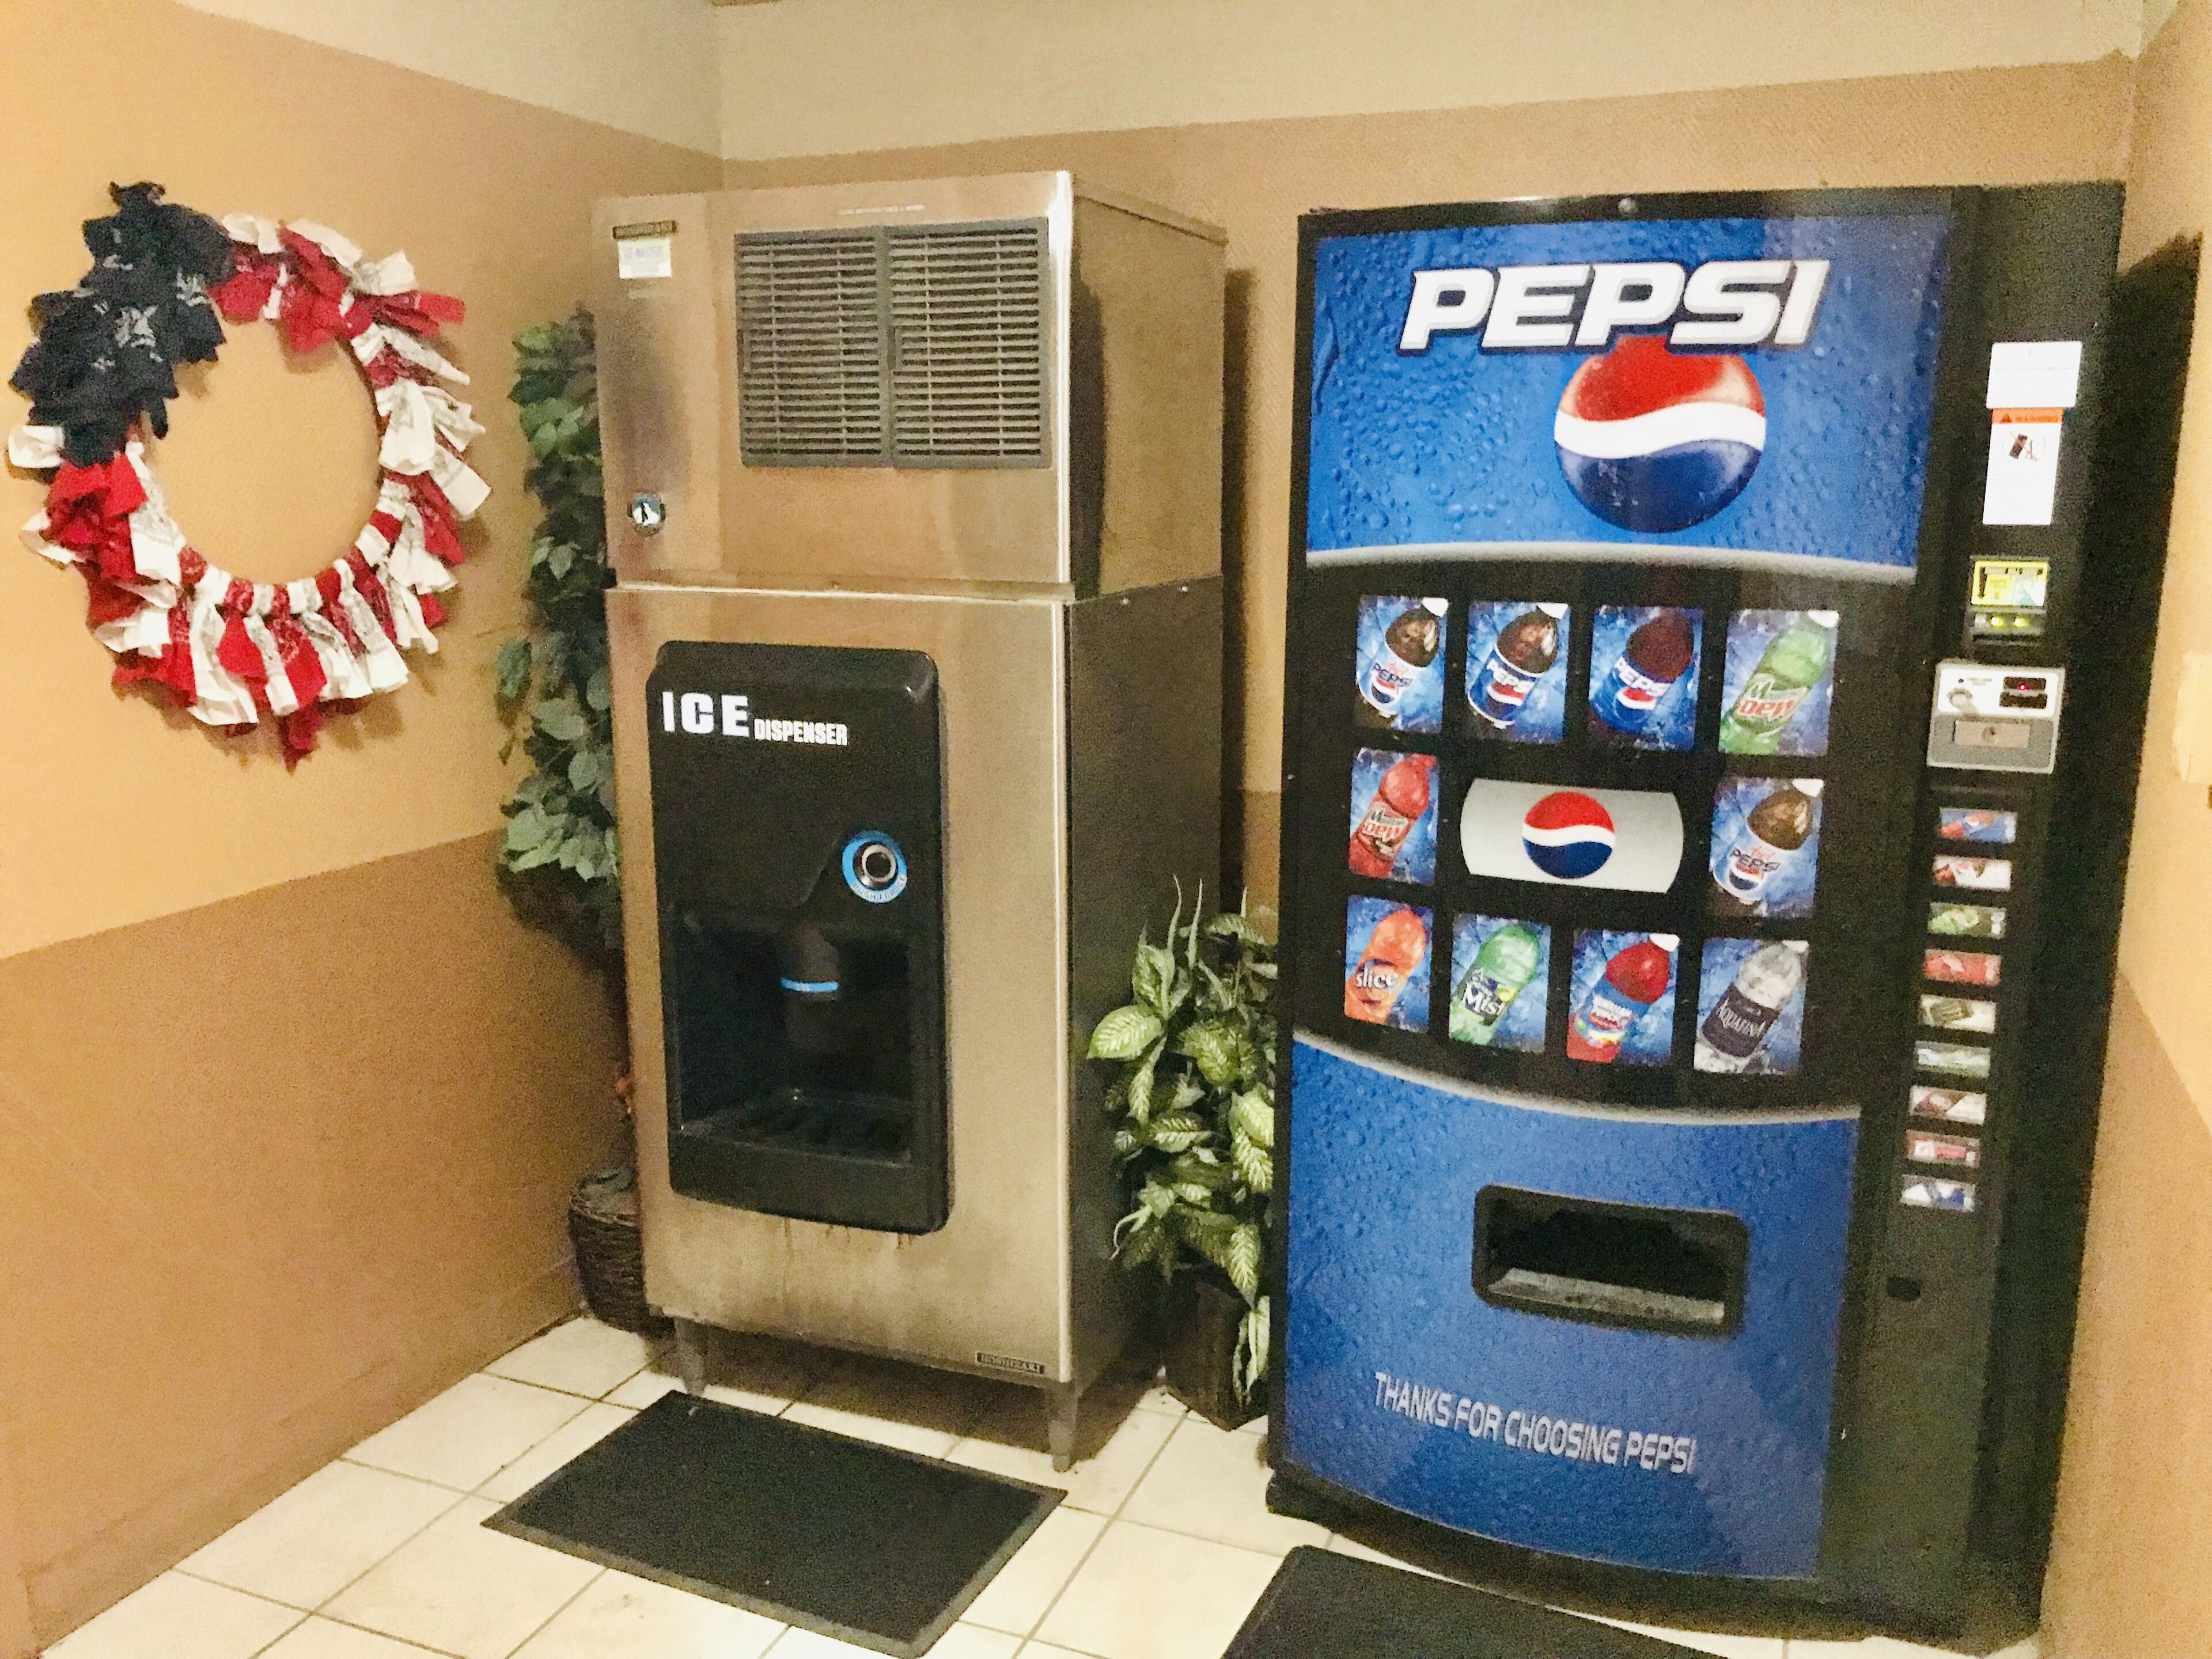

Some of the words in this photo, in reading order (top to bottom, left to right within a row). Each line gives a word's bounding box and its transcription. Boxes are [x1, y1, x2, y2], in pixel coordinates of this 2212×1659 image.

[1400, 260, 1830, 349] PEPSI
[662, 691, 749, 737] ICE
[753, 718, 848, 745] DISPENSER
[1374, 1371, 1453, 1428] THANKS
[1453, 1397, 1502, 1441] FOR
[1504, 1410, 1624, 1466] CHOOSING
[1623, 1430, 1698, 1475] PEPSI
